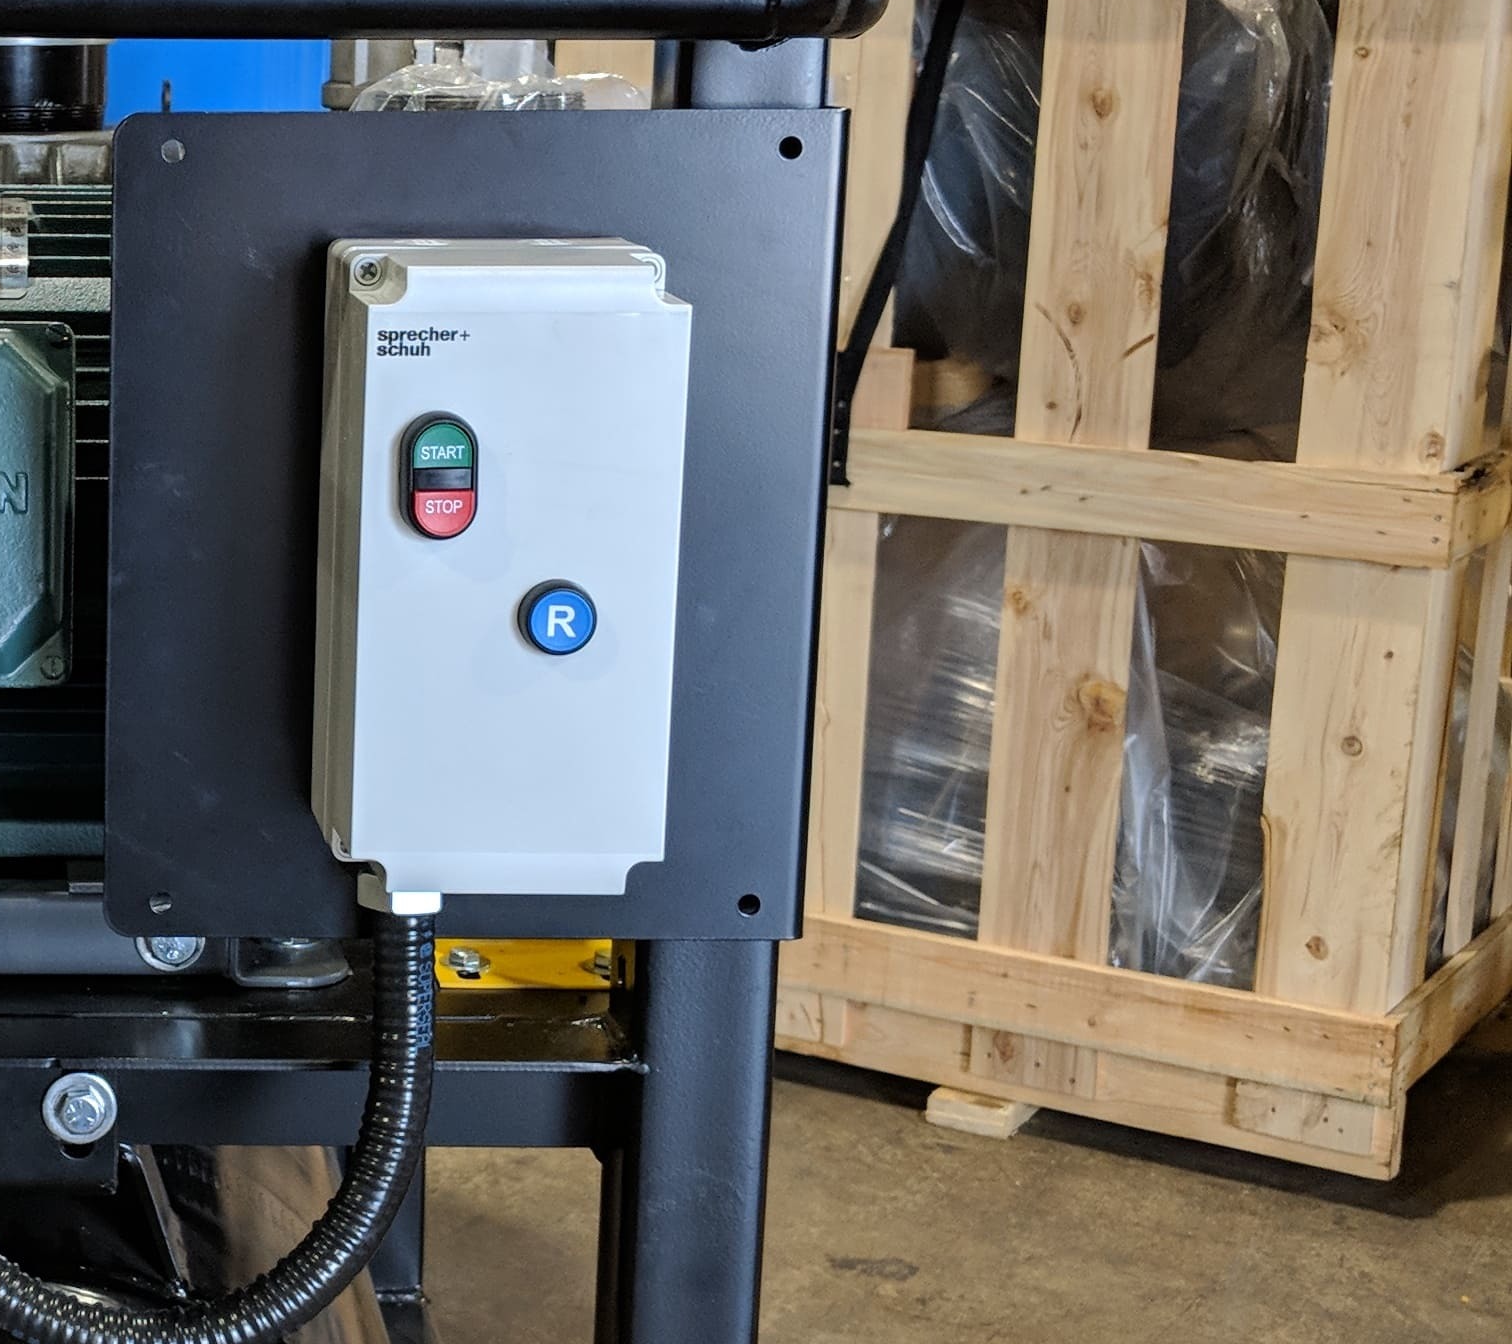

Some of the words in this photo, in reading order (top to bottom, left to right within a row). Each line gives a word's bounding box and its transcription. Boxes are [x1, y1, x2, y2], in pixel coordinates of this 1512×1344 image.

[376, 342, 431, 357] schuh
[420, 445, 465, 460] START
[425, 499, 463, 514] STOP
[546, 604, 576, 638] R
